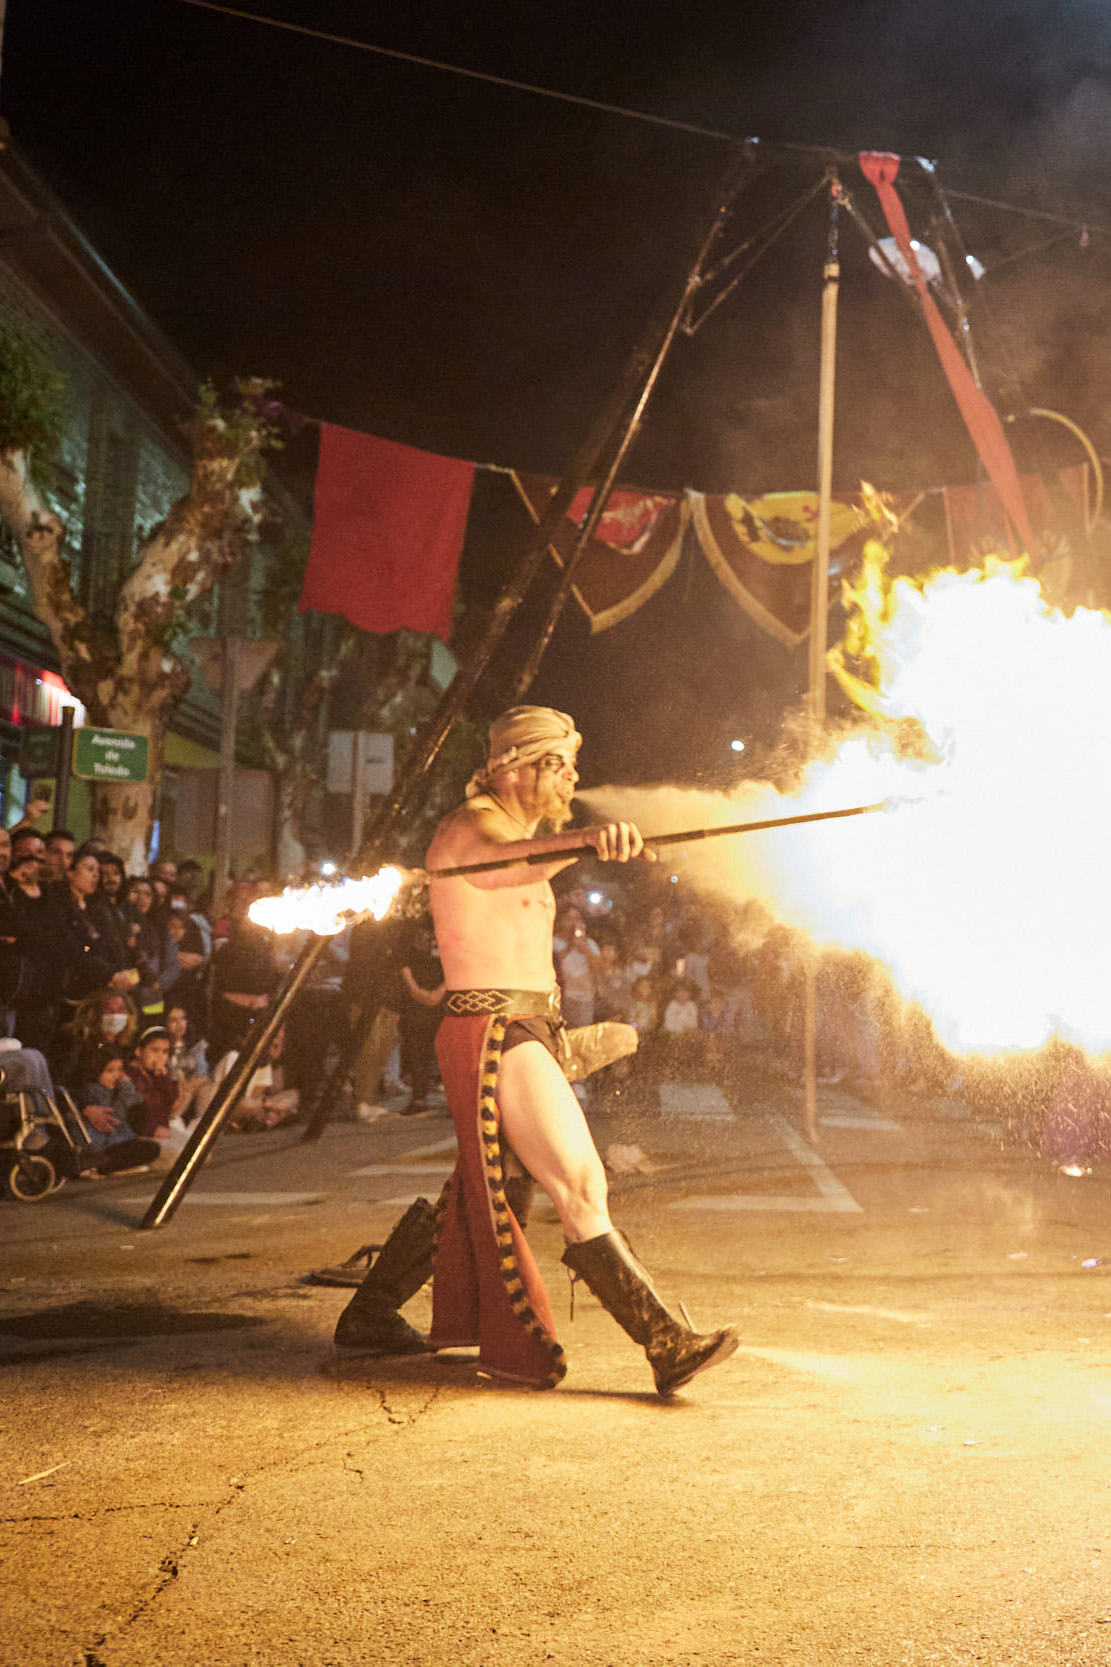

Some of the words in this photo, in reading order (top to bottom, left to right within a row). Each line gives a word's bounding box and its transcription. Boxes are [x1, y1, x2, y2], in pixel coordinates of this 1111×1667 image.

[91, 734, 136, 749] Avenida
[105, 750, 119, 761] de
[94, 762, 130, 776] Toledo
